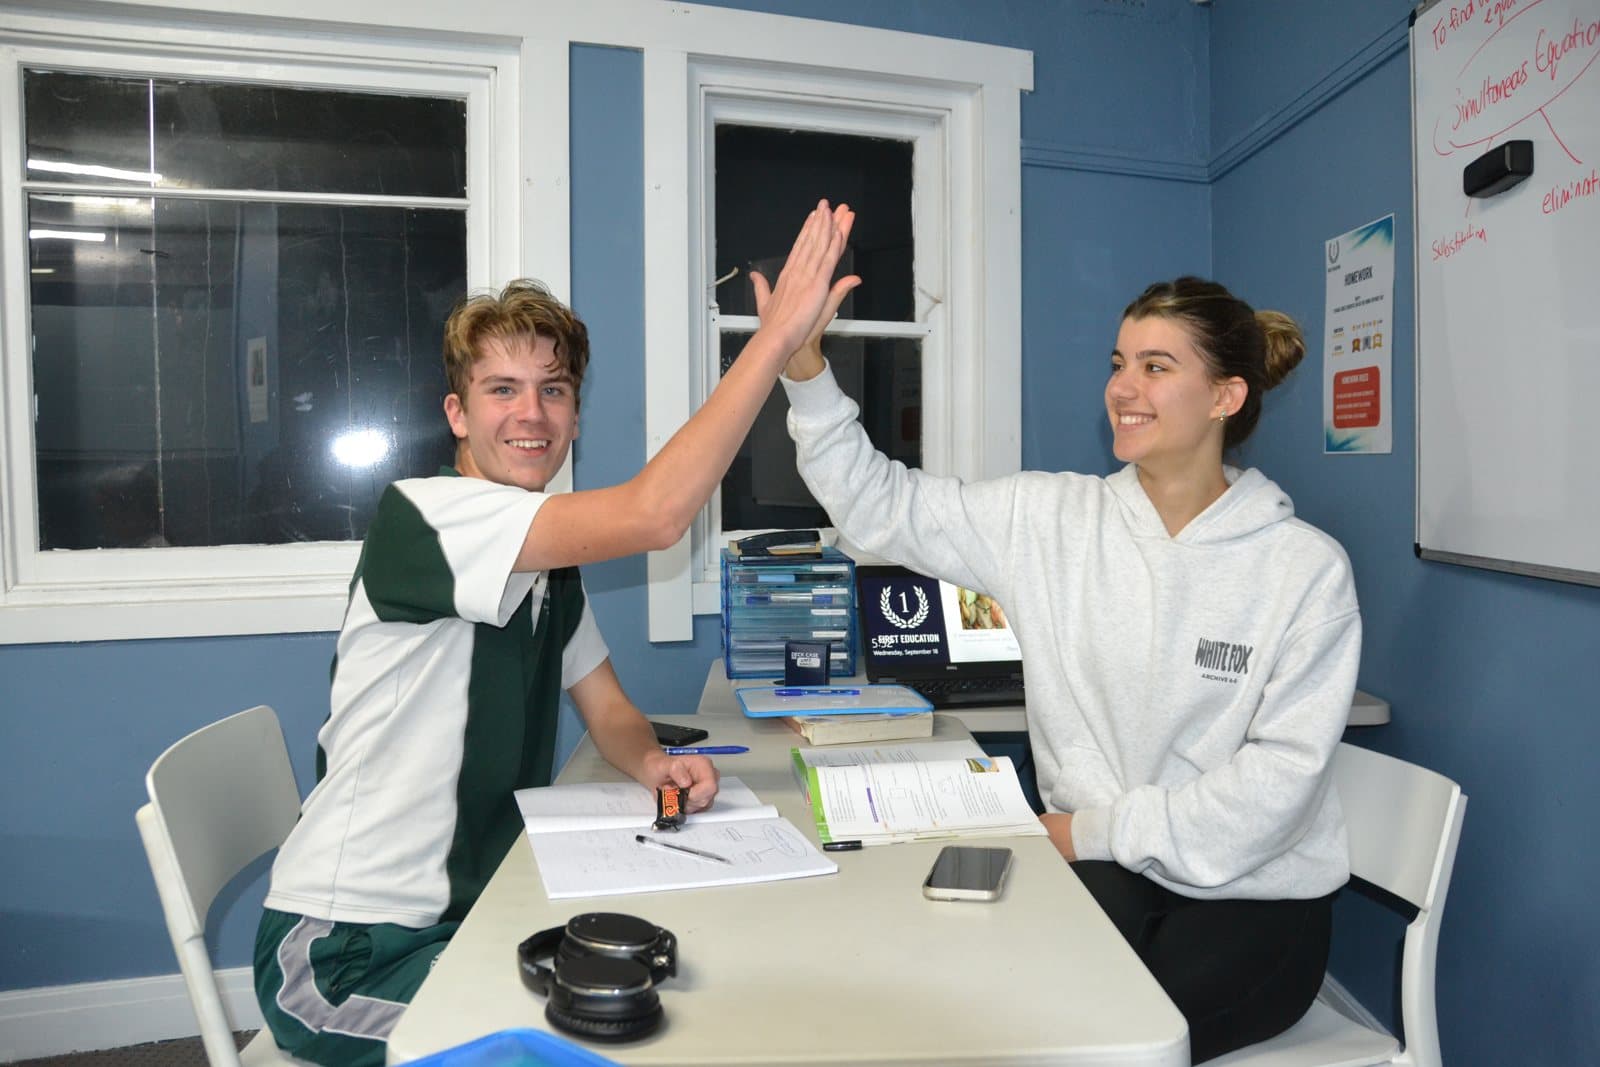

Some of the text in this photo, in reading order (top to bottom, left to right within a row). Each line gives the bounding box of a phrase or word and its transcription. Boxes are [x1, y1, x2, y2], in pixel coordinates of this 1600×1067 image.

[1432, 0, 1475, 50] To find
[1535, 16, 1600, 81] Equatio
[1542, 168, 1600, 215] eliminat
[900, 633, 940, 644] EDUCATION
[904, 648, 932, 656] September
